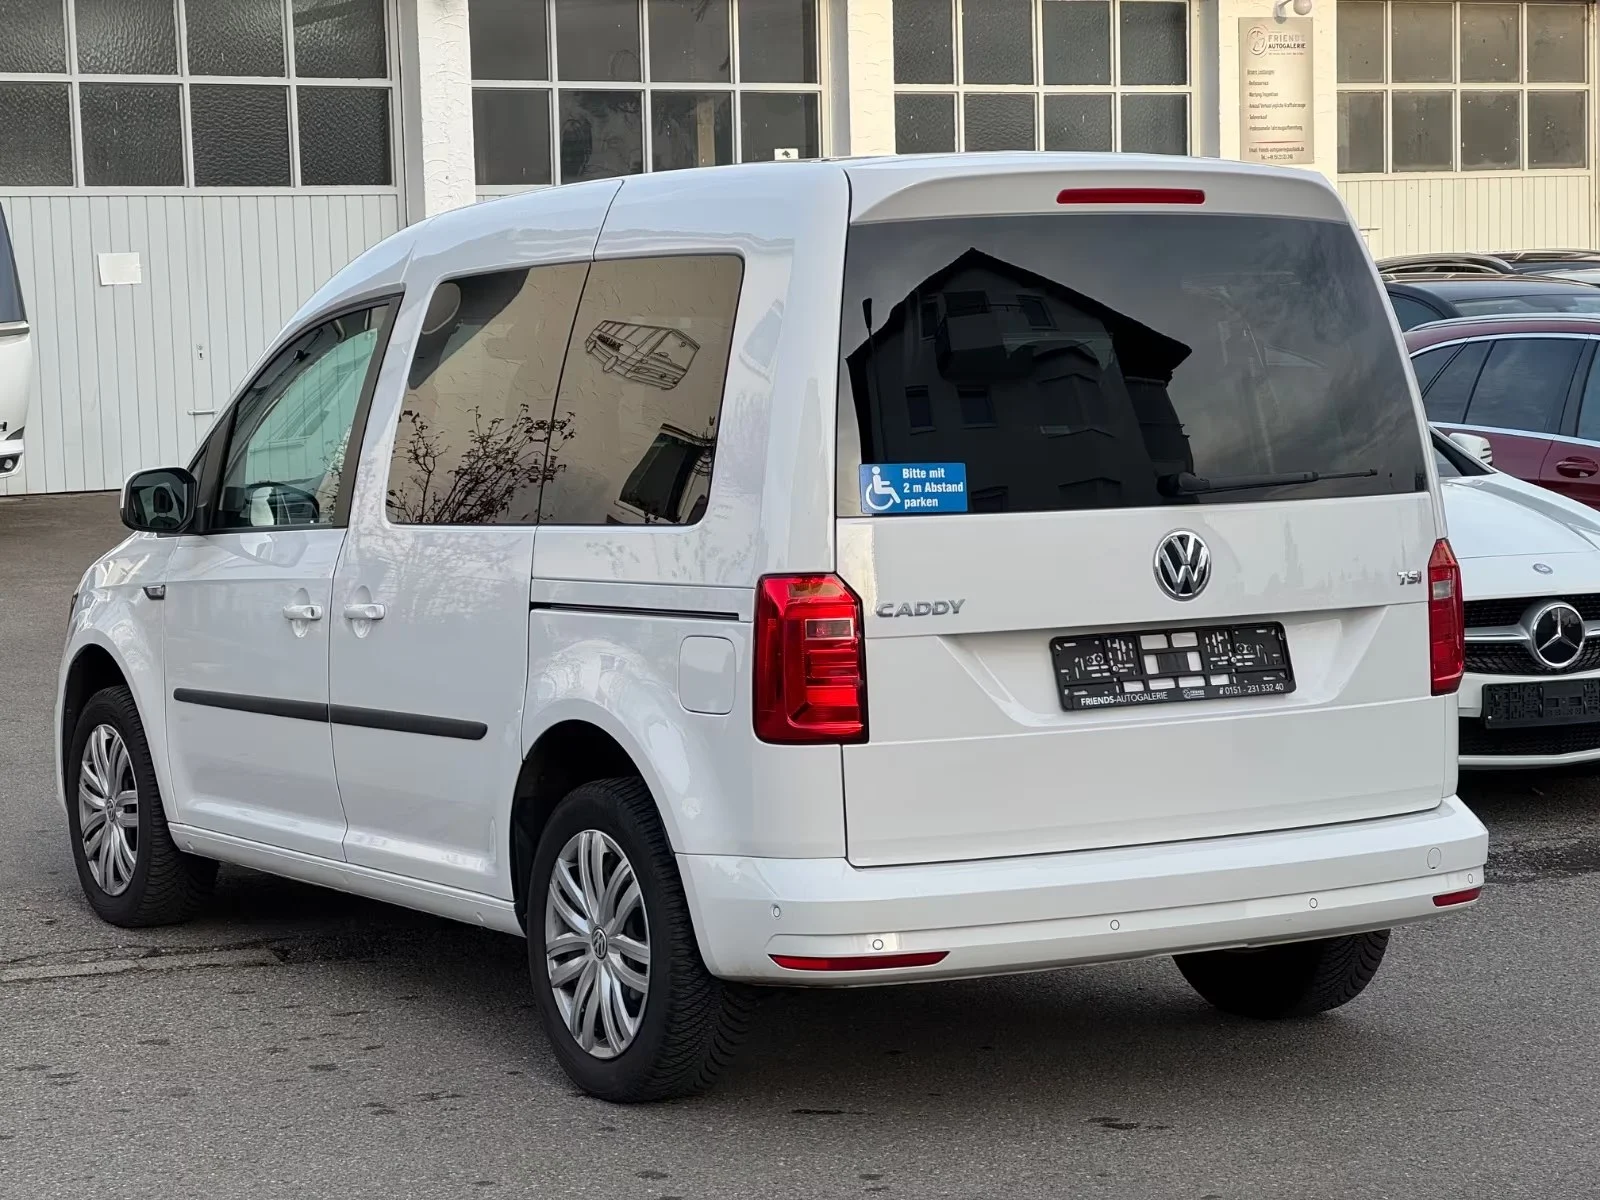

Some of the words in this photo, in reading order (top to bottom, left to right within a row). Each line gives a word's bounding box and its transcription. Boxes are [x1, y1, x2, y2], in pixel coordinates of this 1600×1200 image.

[902, 468, 926, 479] Bitte
[929, 467, 945, 478] mit
[903, 482, 910, 493] 2
[913, 484, 922, 493] m
[924, 481, 964, 493] Abstand
[904, 497, 939, 510] parken
[1397, 570, 1422, 585] TSI
[876, 599, 966, 618] CADDY
[1225, 686, 1241, 695] 0151
[1247, 684, 1260, 693] 231
[1261, 683, 1274, 692] 332
[1275, 683, 1284, 691] 40
[1080, 691, 1168, 706] FRIENDS-AUTOGALERIE
